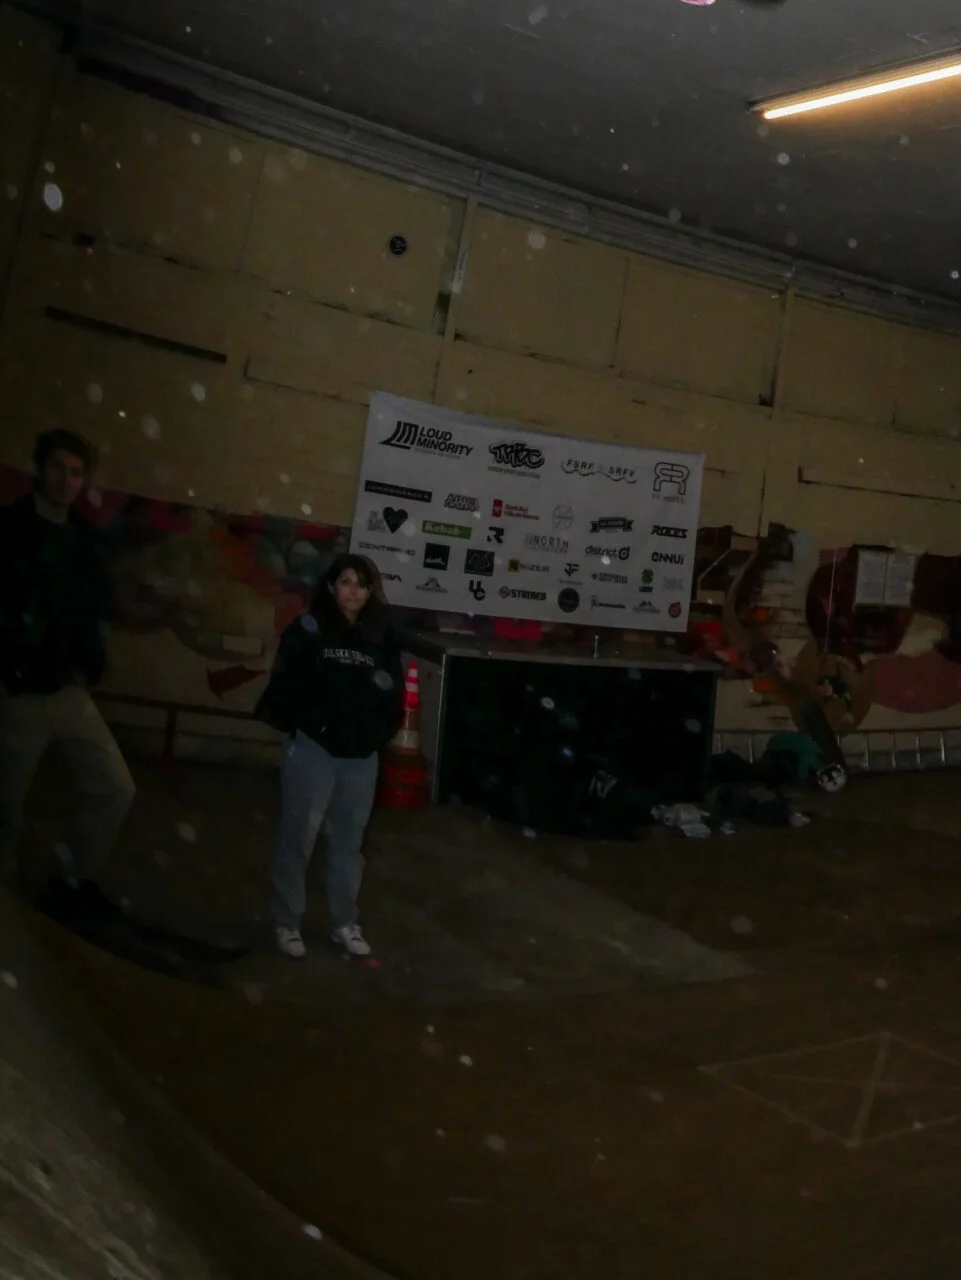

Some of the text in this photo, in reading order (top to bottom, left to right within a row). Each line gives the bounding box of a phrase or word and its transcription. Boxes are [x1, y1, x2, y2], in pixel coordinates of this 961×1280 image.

[419, 426, 453, 441] LOUD
[416, 437, 474, 456] MINORITY
[533, 535, 569, 549] NORTH
